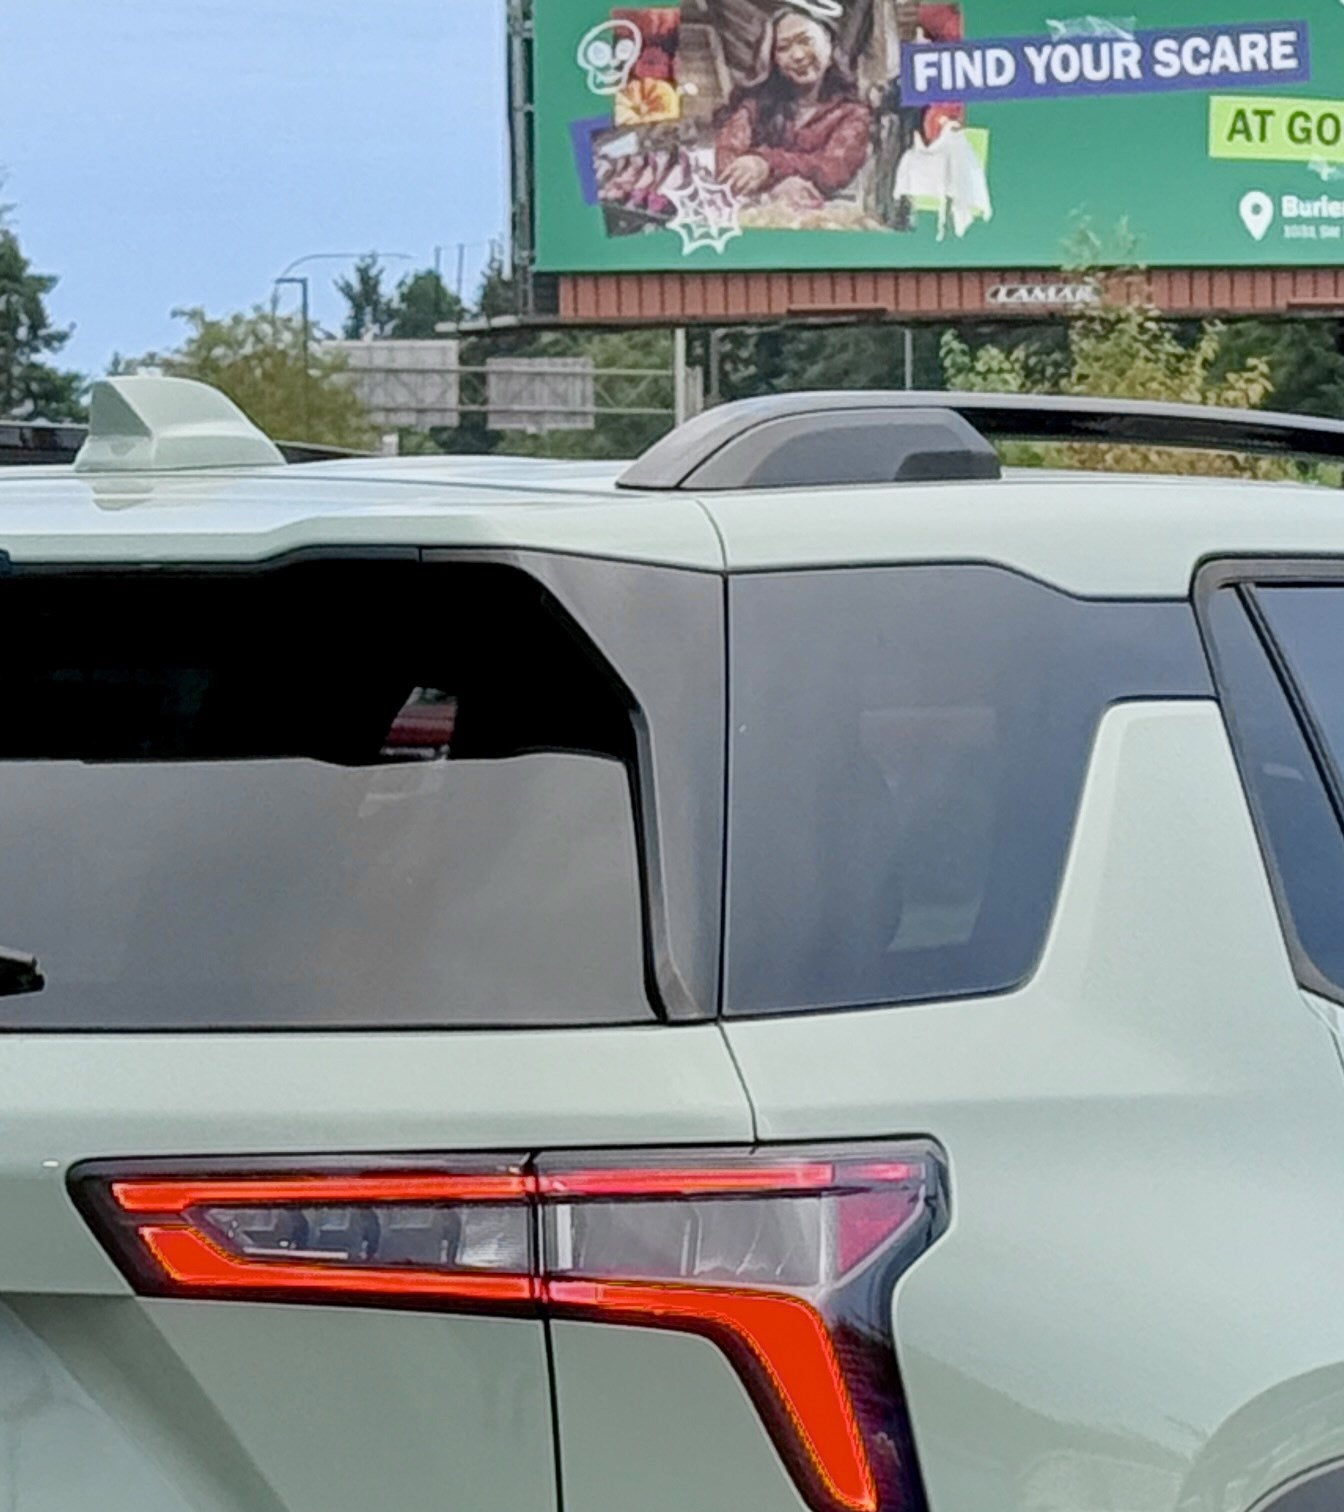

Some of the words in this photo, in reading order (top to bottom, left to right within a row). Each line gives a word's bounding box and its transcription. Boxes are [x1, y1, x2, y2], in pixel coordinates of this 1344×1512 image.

[913, 50, 1016, 92] FIND
[1024, 40, 1143, 84] YOUR
[1153, 31, 1299, 78] SCARE
[1227, 108, 1275, 143] AT
